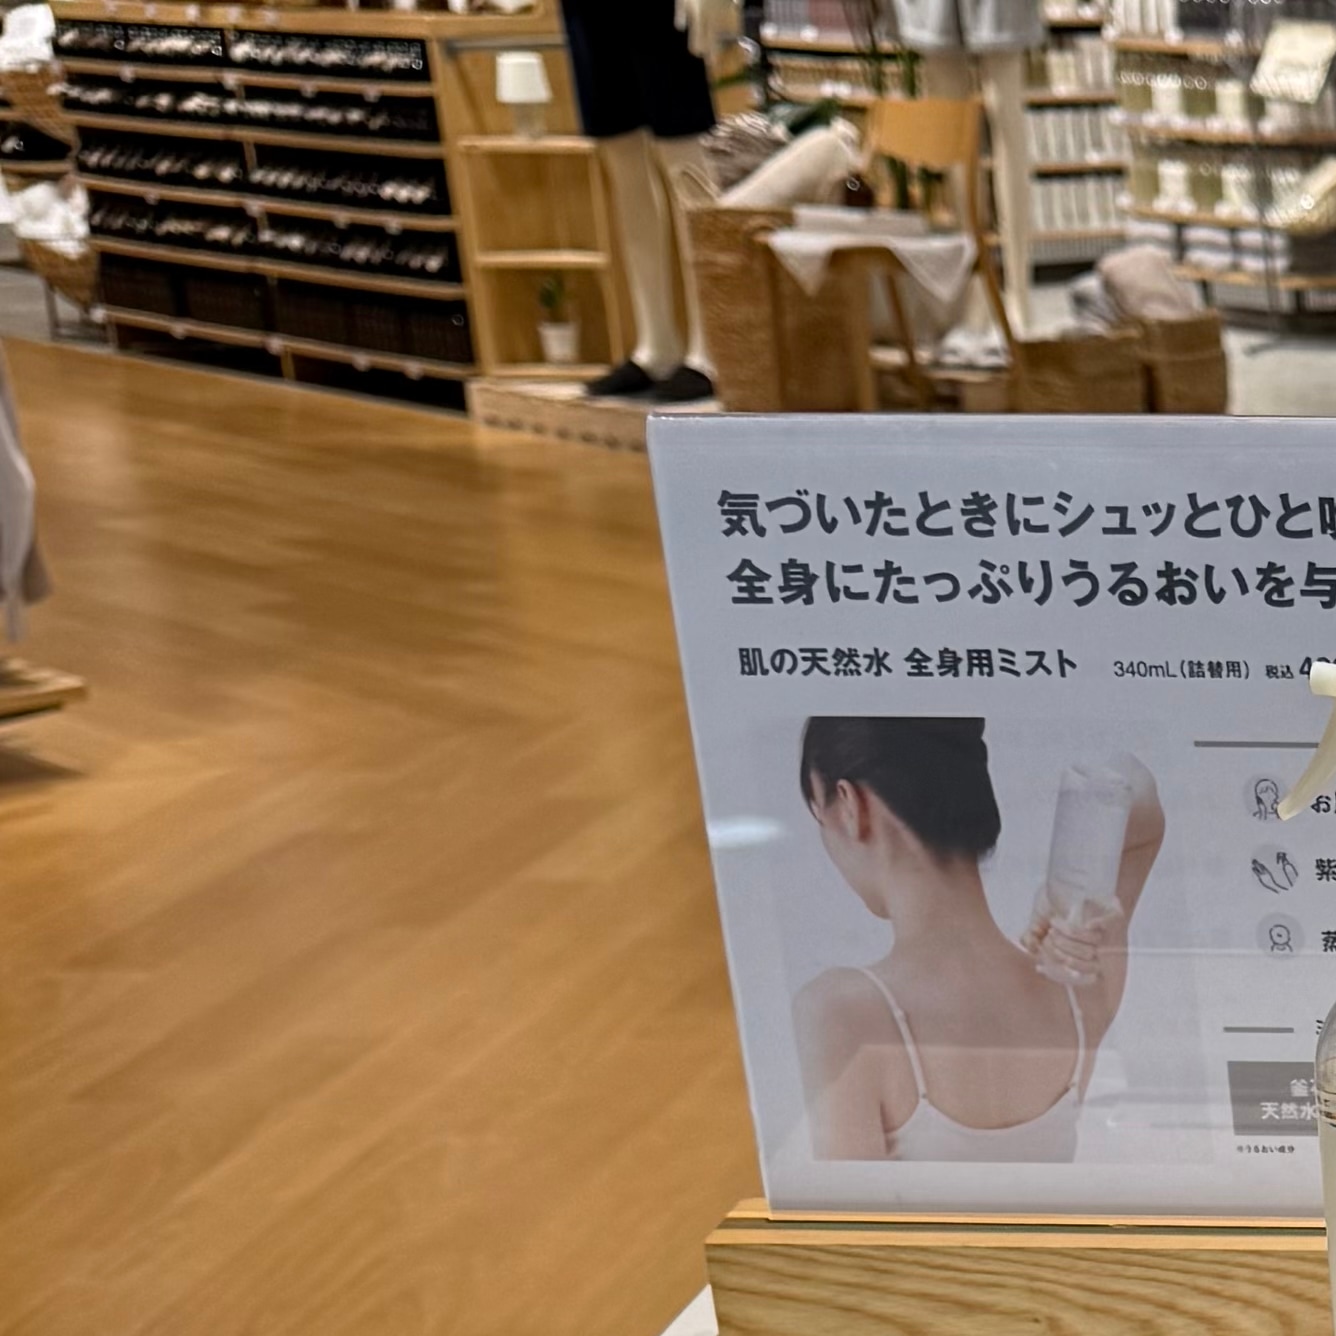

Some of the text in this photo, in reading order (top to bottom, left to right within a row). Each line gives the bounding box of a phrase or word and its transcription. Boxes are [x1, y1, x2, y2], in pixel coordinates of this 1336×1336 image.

[738, 646, 892, 679] 肌の天然水
[906, 646, 1078, 679] 全身用ミスト
